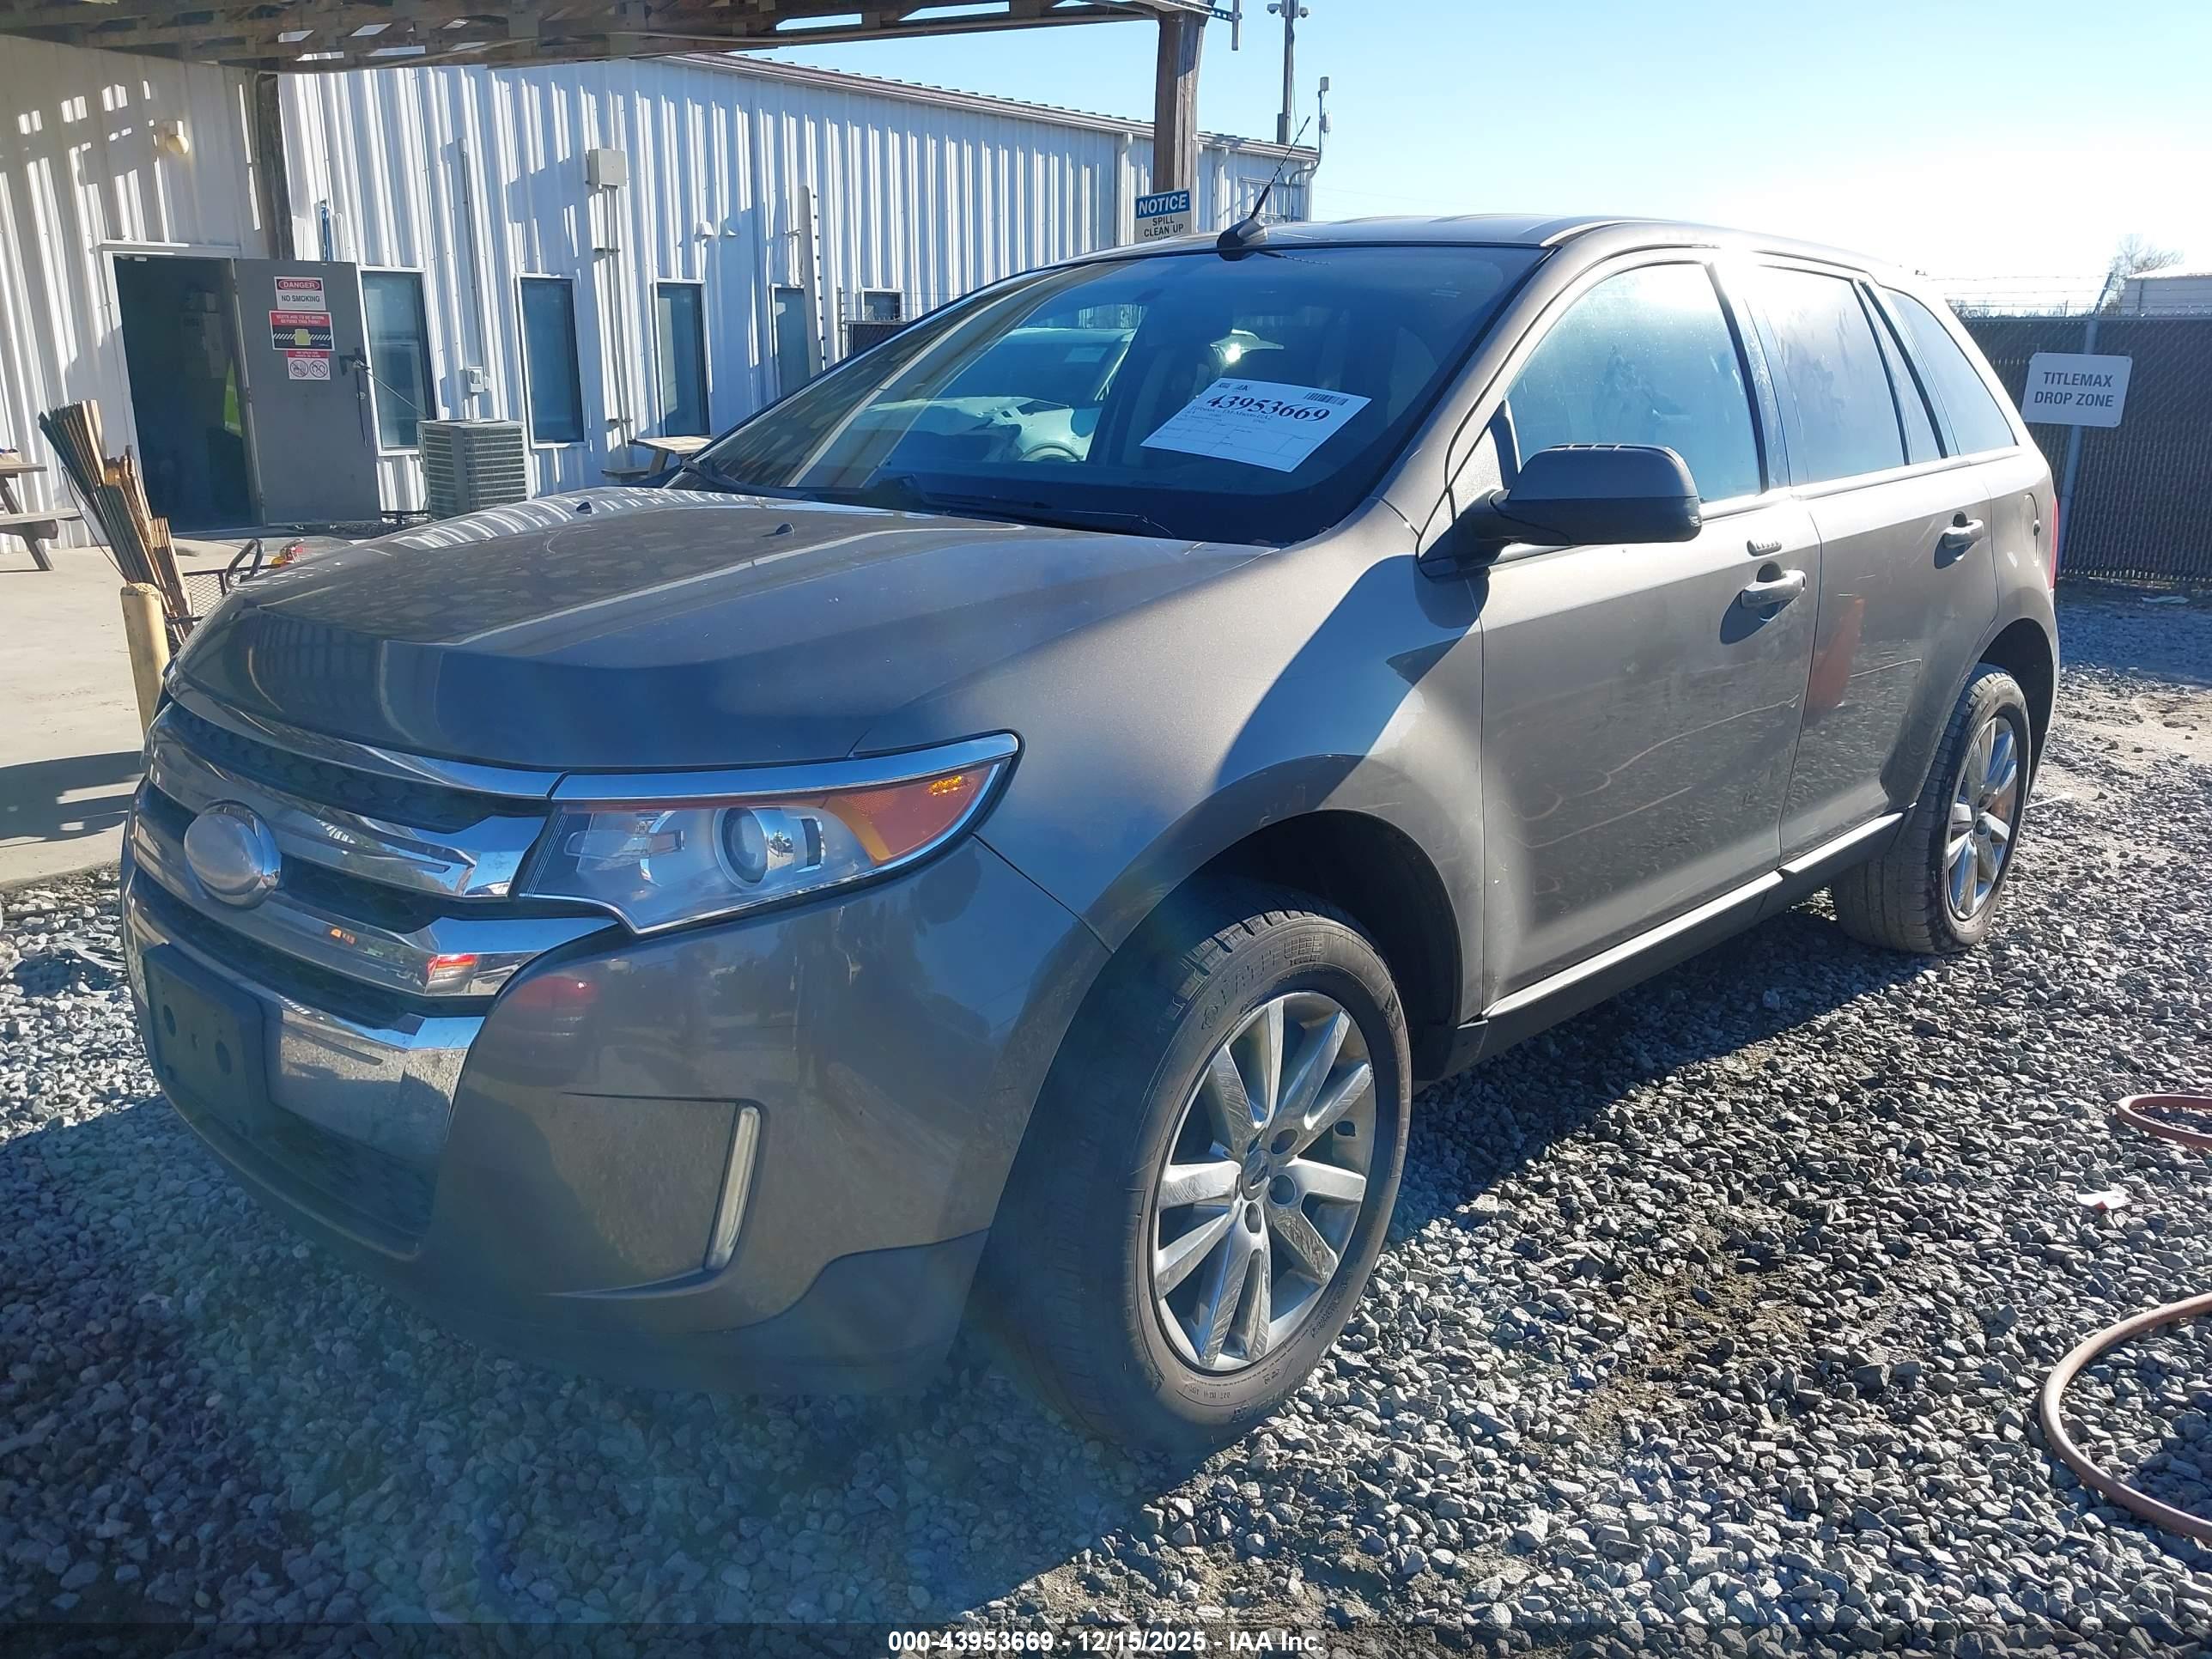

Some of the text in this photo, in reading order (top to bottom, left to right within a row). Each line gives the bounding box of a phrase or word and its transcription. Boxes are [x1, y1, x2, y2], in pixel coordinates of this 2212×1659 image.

[1138, 193, 1188, 216] NOTICE
[1152, 215, 1175, 227] SPILL
[1144, 223, 1184, 237] CLEAN UP
[2044, 372, 2113, 387] TITLEMAX
[2034, 391, 2114, 407] DROP ZONE
[1206, 394, 1331, 422] 43953669
